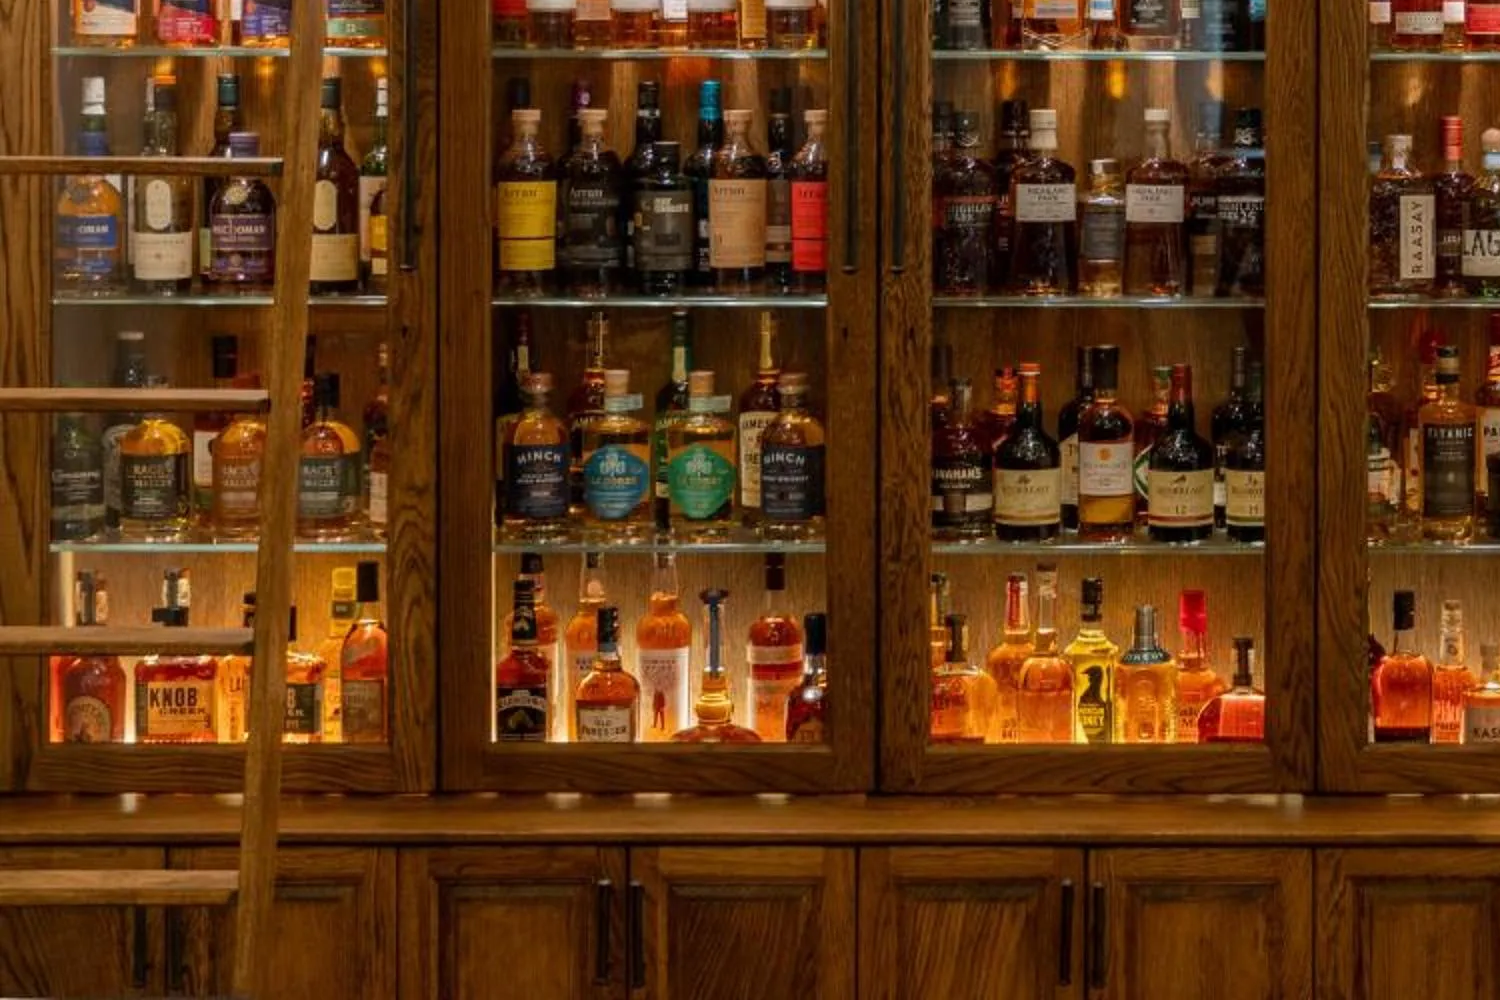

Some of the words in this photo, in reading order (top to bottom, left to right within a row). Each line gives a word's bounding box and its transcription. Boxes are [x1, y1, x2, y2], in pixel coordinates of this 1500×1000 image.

[1410, 201, 1424, 274] RAASAY
[517, 450, 561, 465] HINCH
[763, 451, 805, 466] HINCH
[149, 686, 198, 708] KNOB
[159, 707, 207, 716] CREEK
